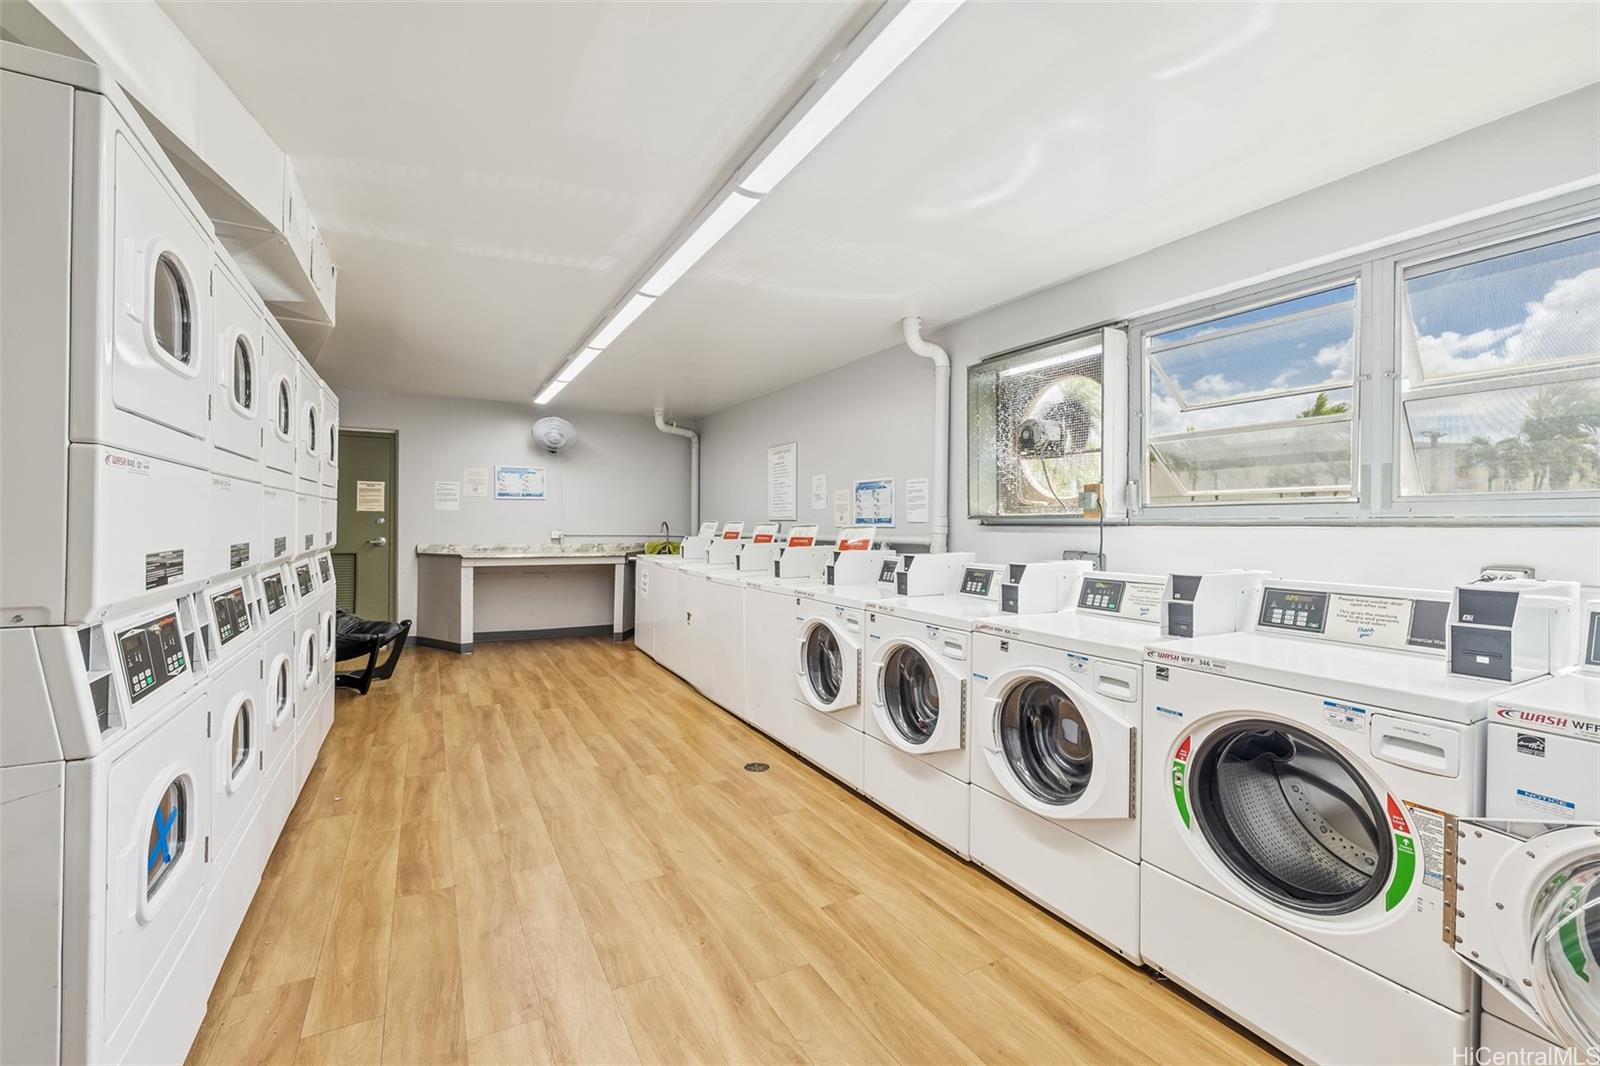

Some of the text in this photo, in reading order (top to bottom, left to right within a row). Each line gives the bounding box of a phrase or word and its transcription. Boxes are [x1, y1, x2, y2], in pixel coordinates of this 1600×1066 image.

[1157, 652, 1180, 661] WASH
[1520, 711, 1568, 728] WASH
[1525, 792, 1567, 805] NOTICE
